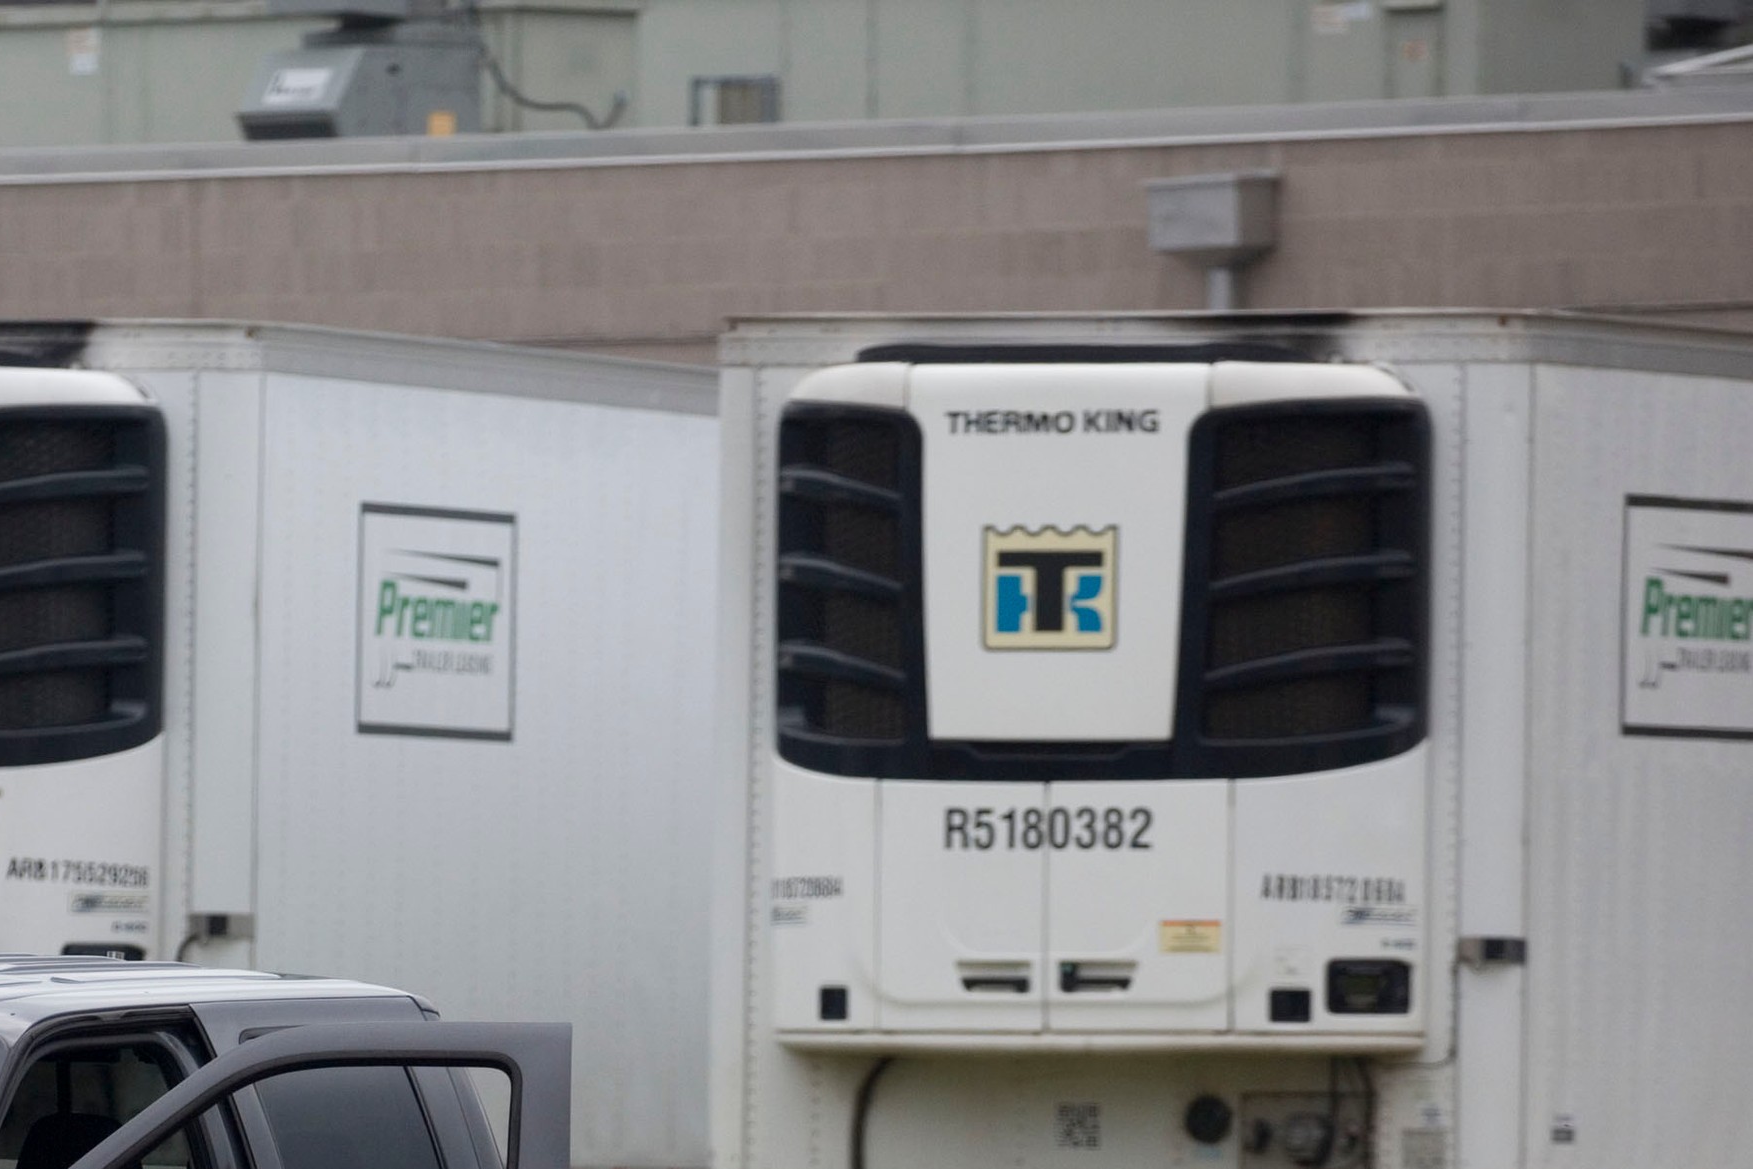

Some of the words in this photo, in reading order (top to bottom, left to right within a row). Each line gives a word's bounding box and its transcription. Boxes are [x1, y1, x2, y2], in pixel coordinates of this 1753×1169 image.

[945, 409, 1075, 433] THERMO
[1083, 409, 1159, 433] KING
[375, 579, 499, 642] Premier
[945, 807, 1153, 850] R5180382
